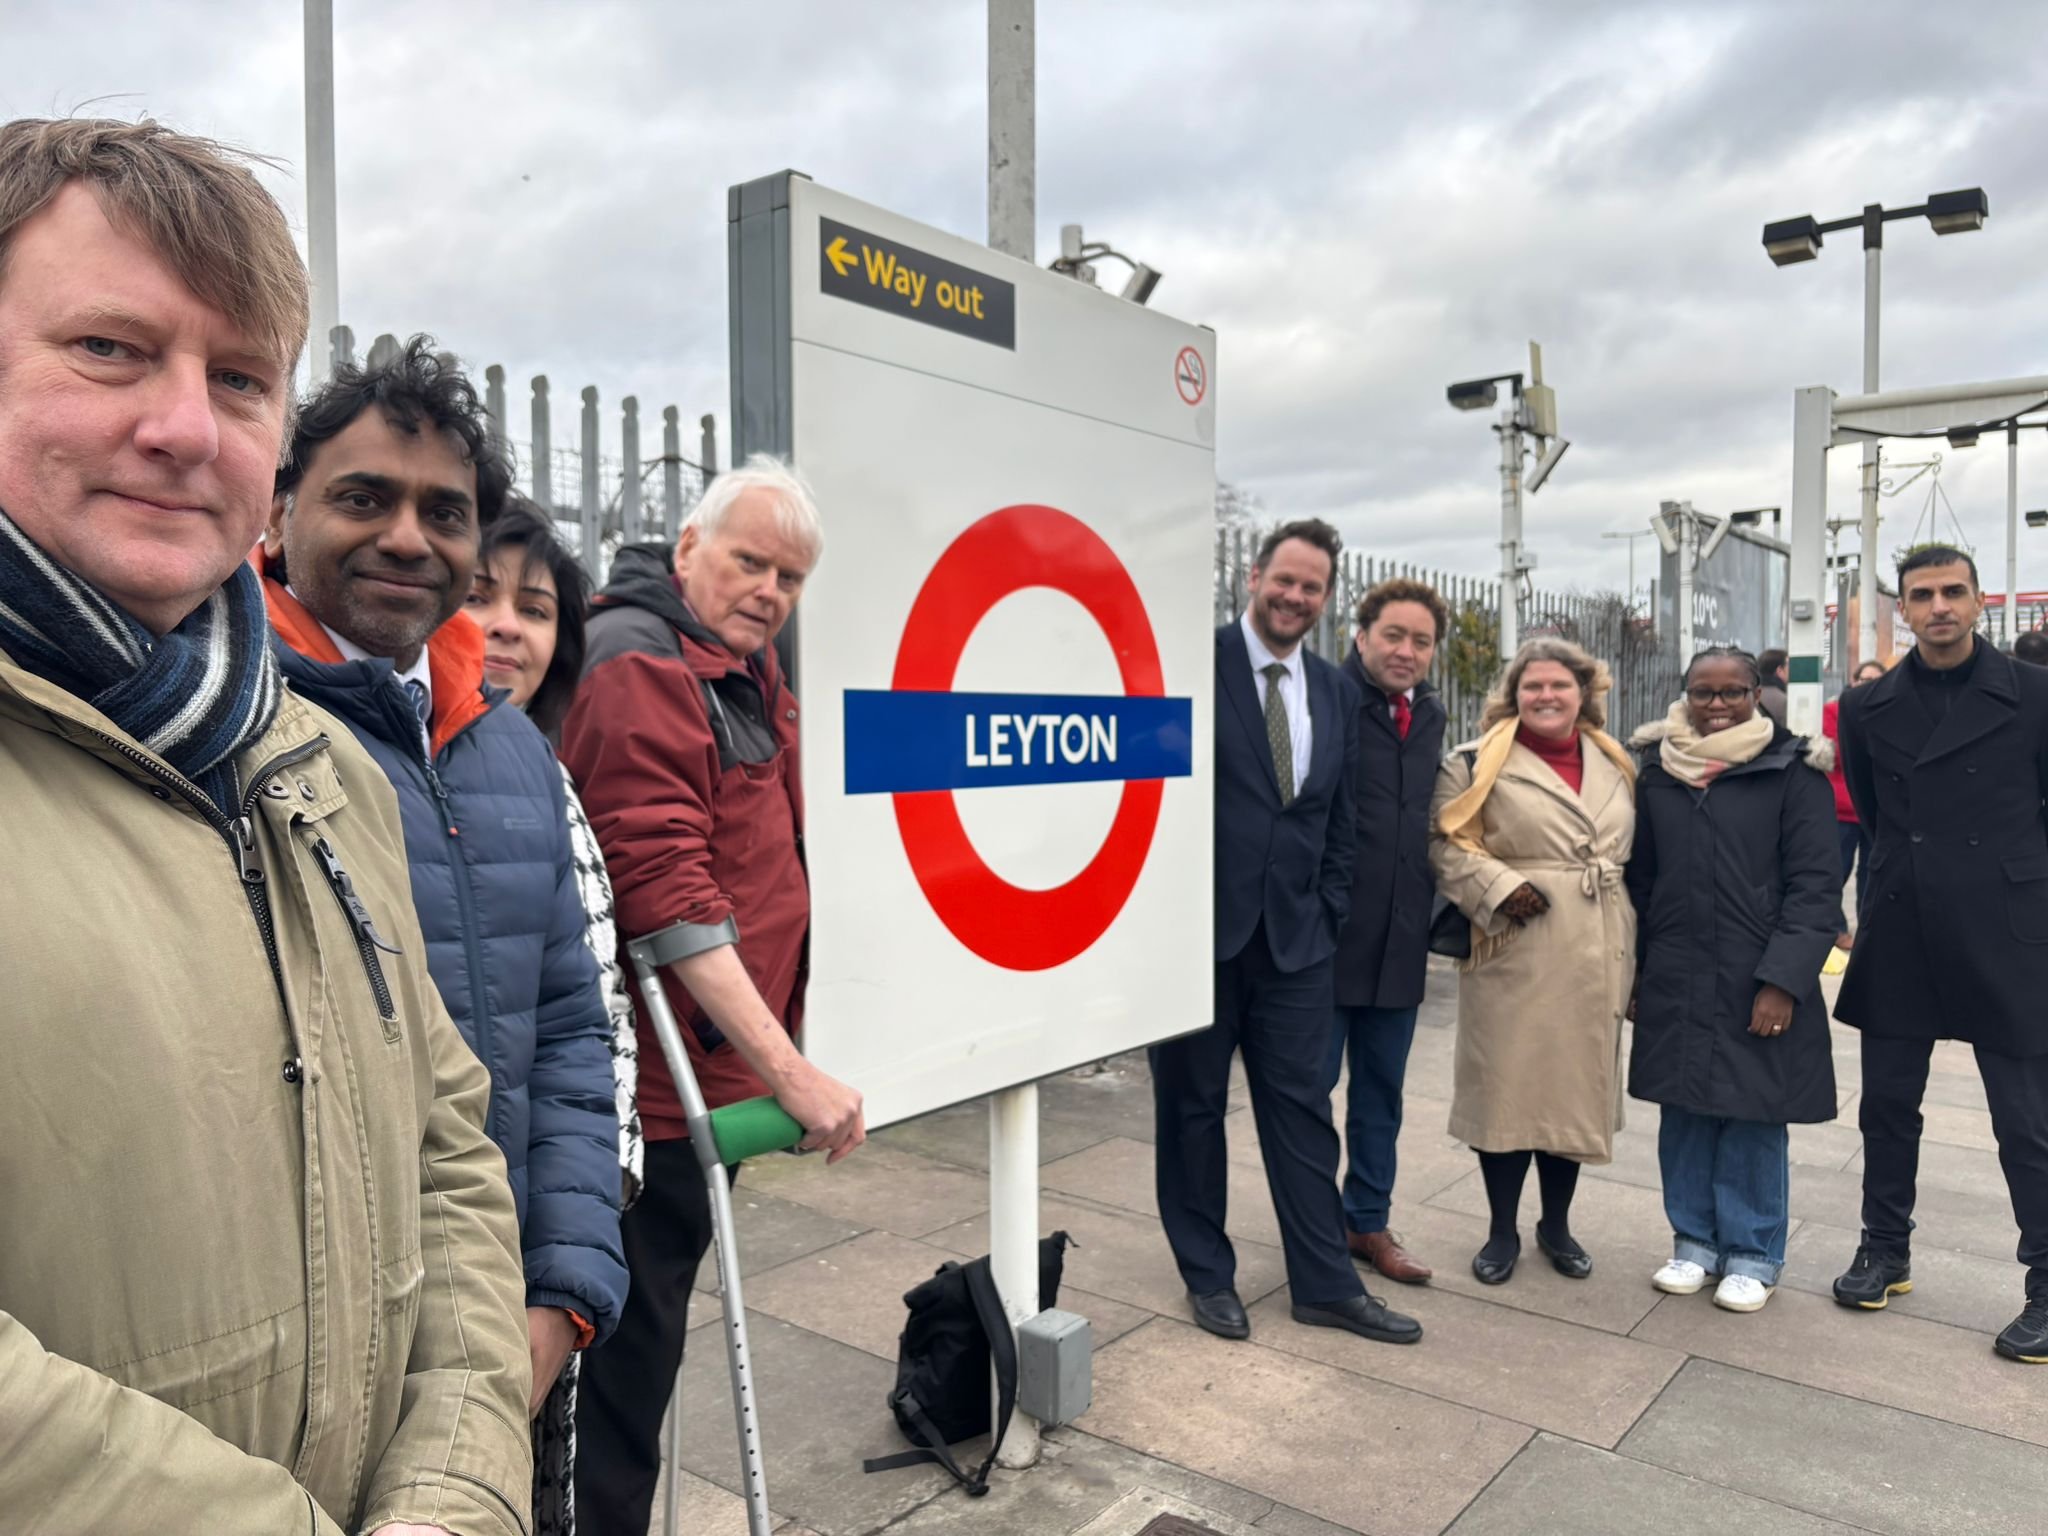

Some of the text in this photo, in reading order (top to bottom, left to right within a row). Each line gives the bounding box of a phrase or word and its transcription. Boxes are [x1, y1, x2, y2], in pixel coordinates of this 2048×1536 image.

[862, 244, 984, 320] Way out
[966, 713, 1117, 767] LEYTON
